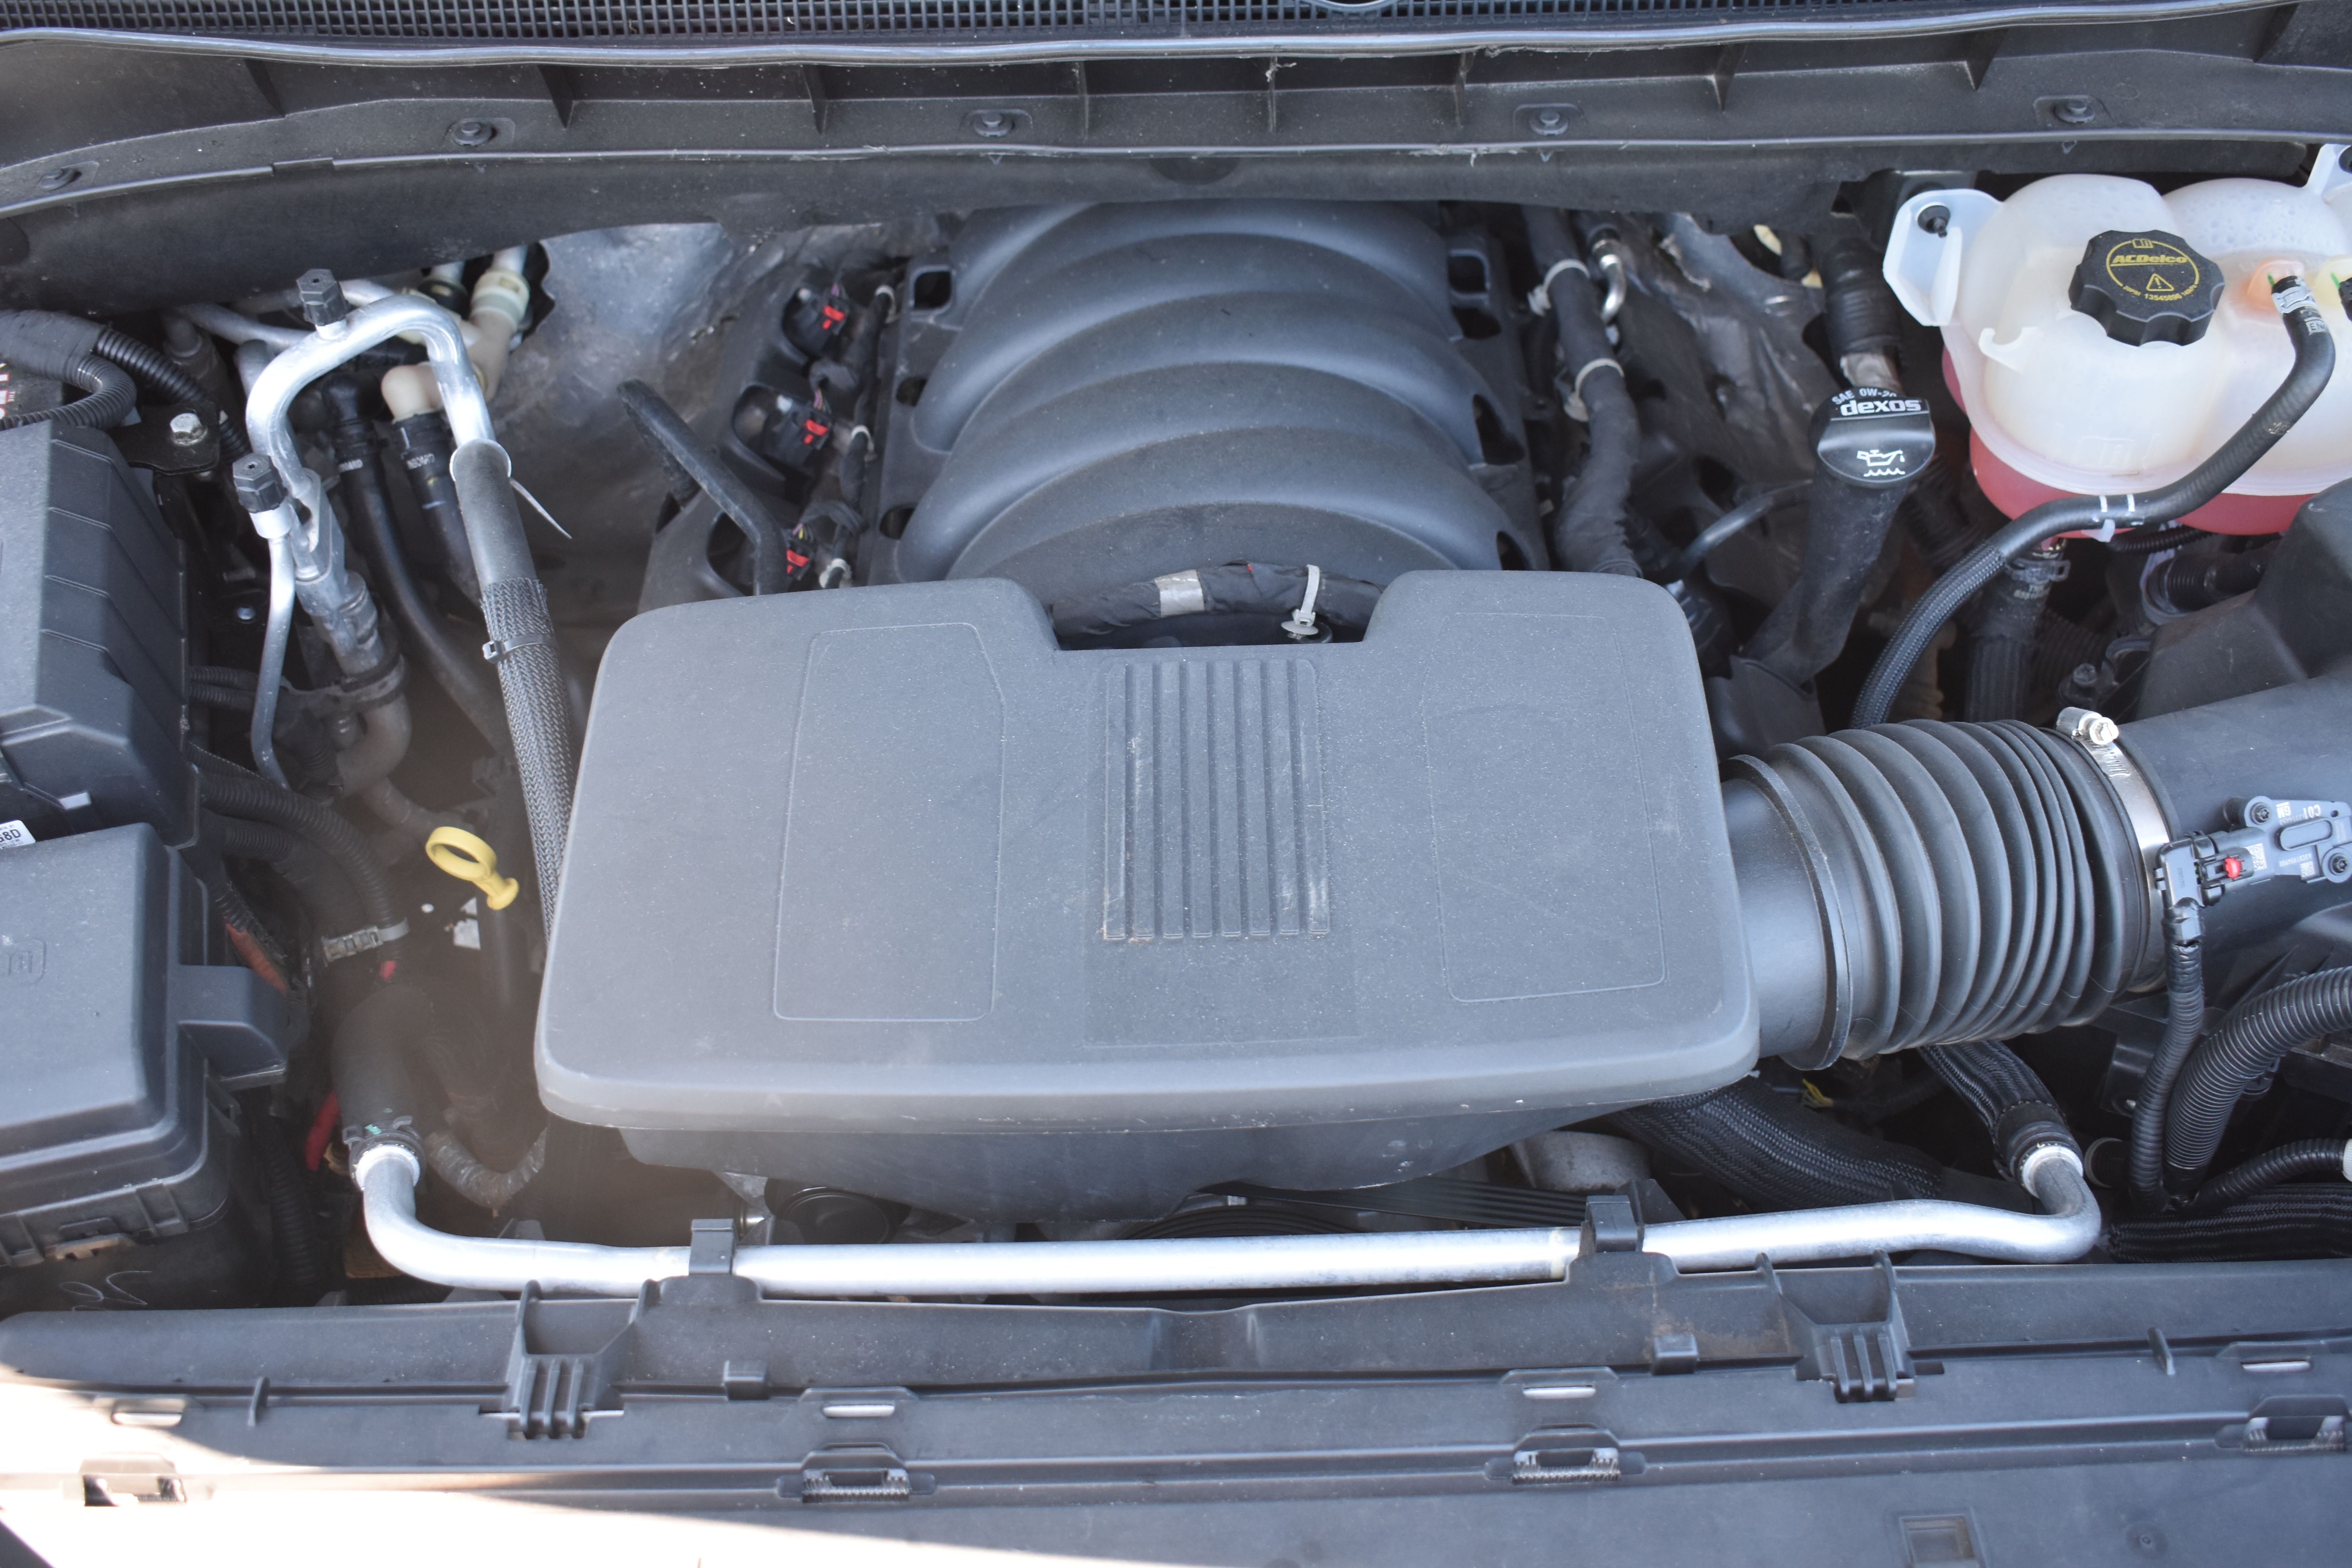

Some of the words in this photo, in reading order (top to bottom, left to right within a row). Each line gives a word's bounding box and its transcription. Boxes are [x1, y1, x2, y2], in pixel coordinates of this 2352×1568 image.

[2112, 255, 2187, 263] ACDelco
[1832, 390, 1855, 404] SAE
[1840, 399, 1921, 416] dexos
[2276, 805, 2291, 818] GM
